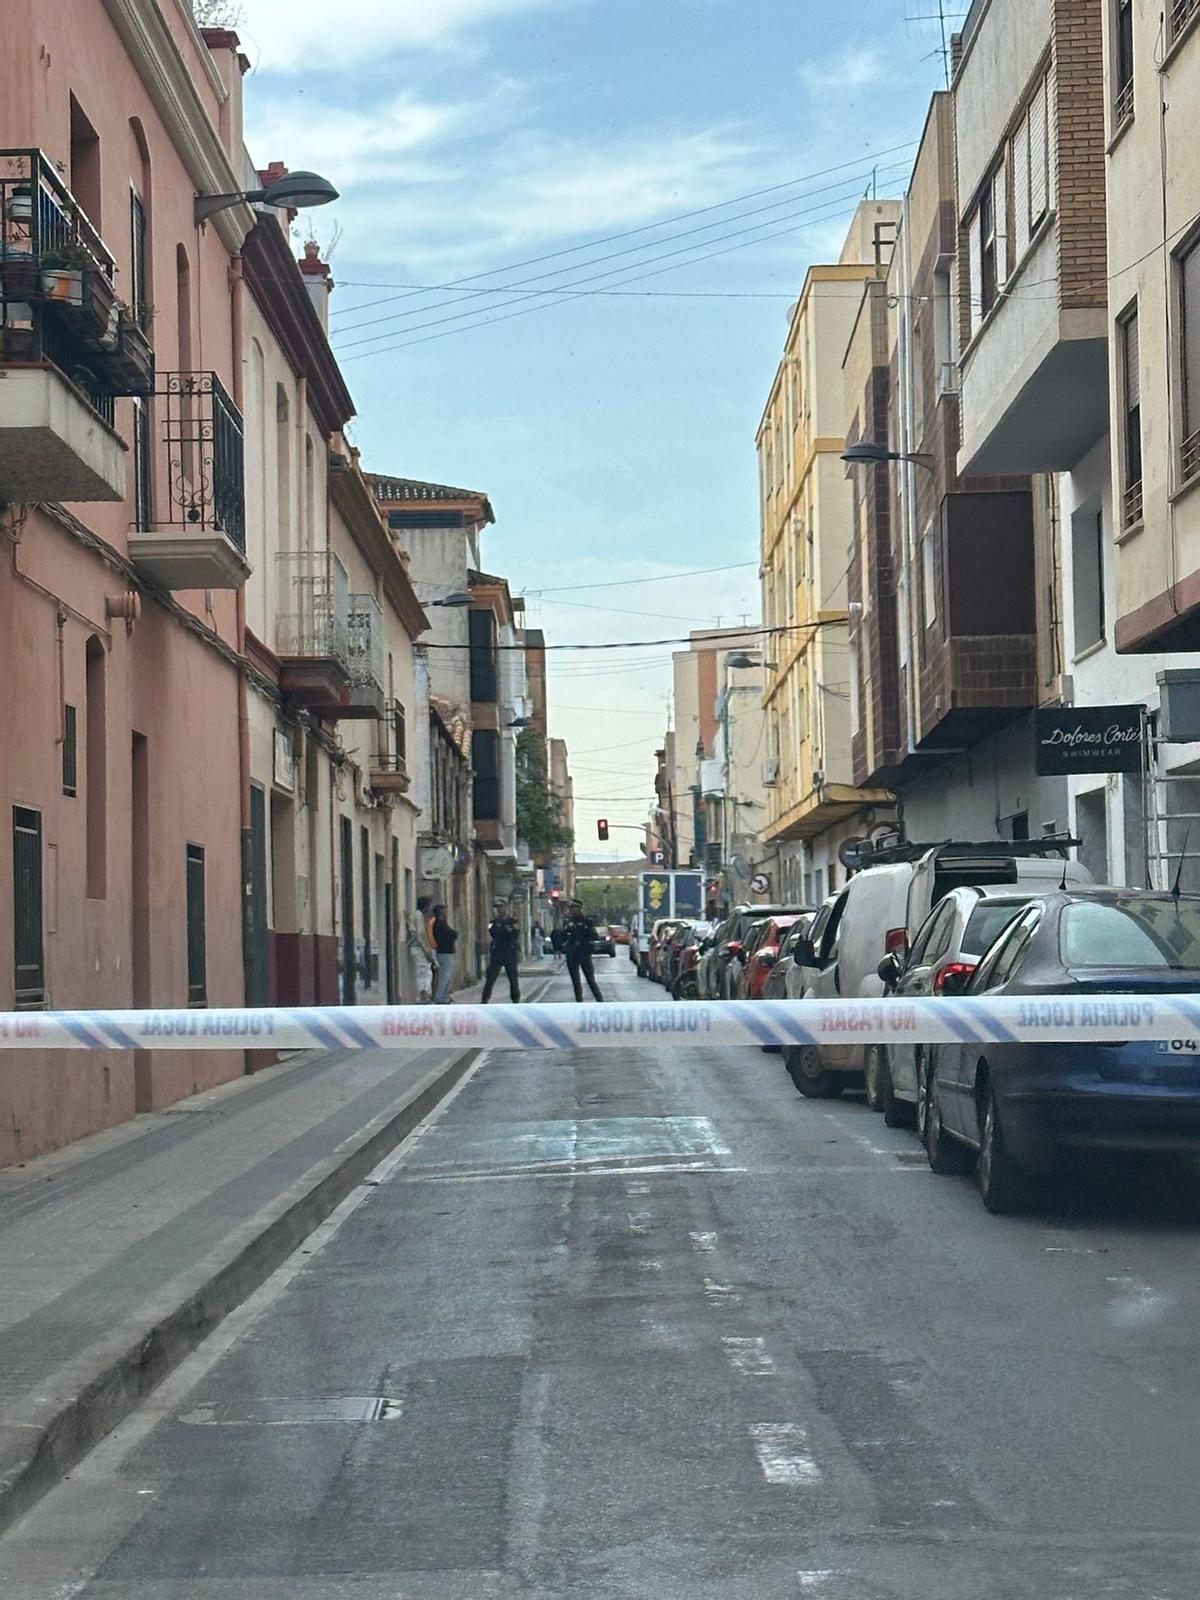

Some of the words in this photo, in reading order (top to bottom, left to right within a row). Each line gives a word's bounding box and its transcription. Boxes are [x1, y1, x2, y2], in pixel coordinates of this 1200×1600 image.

[1041, 725, 1101, 746] Dolores
[1062, 748, 1121, 758] SWIMWEAR
[655, 852, 664, 864] P
